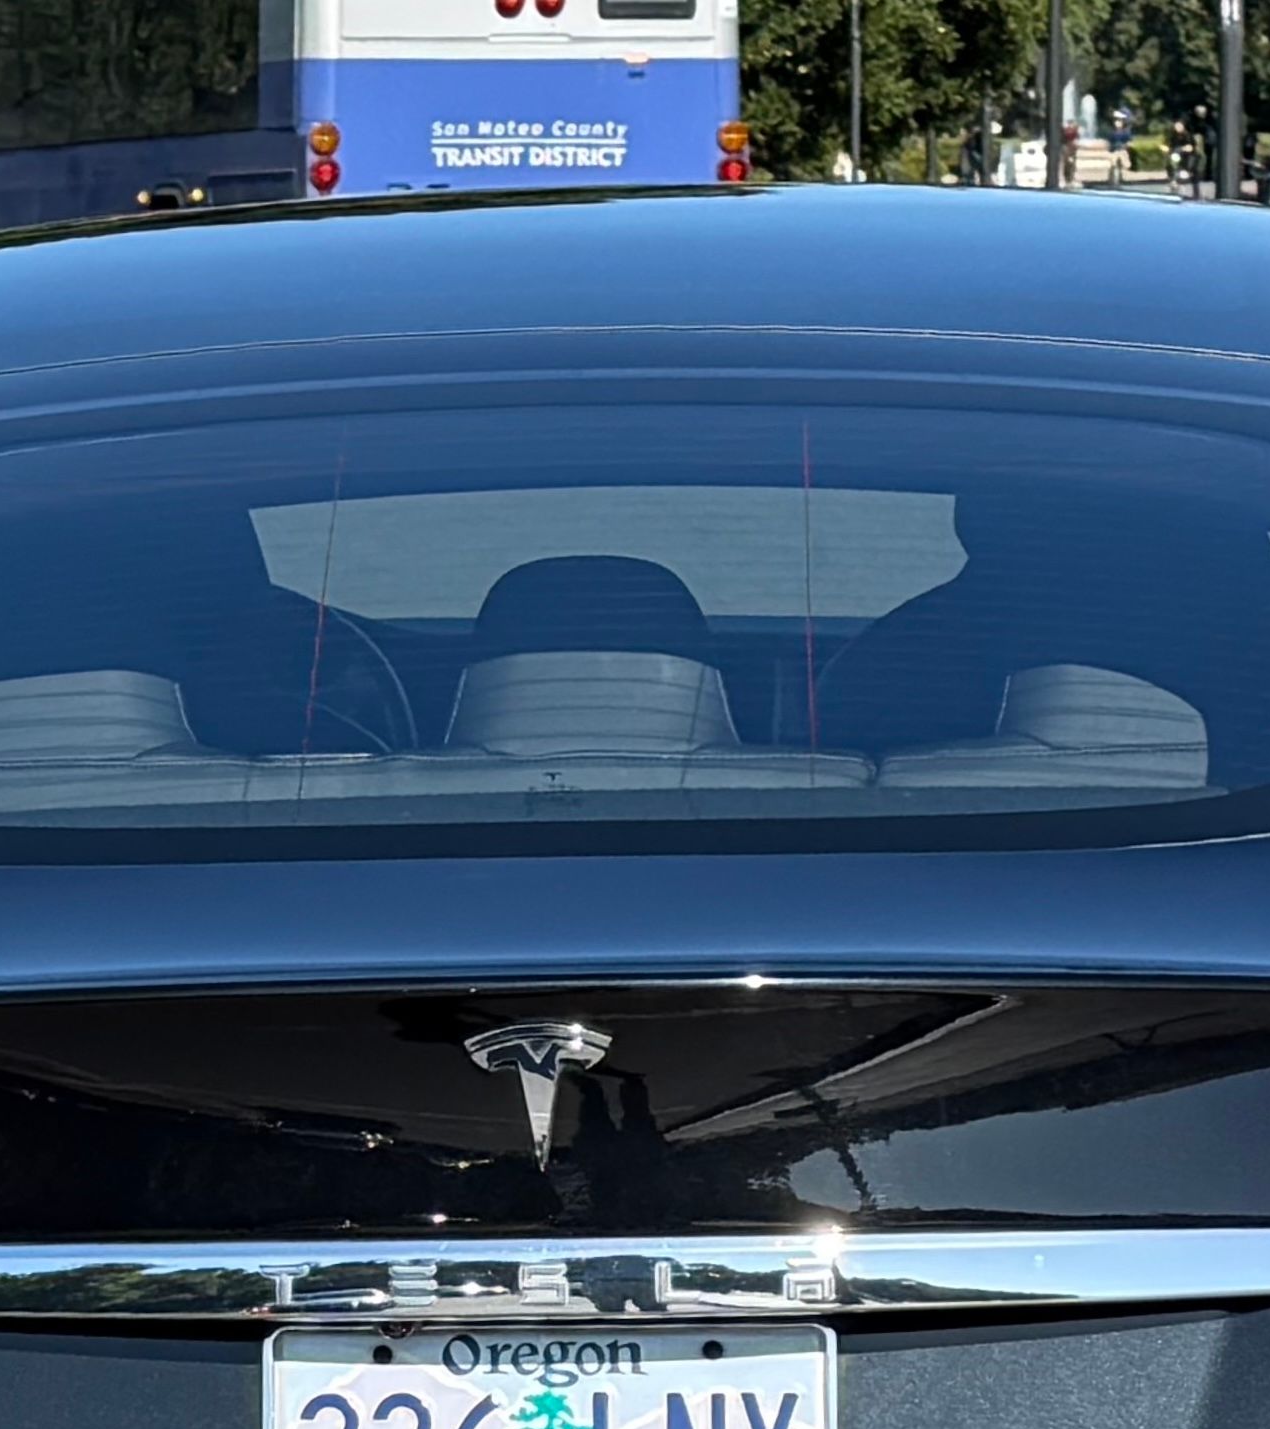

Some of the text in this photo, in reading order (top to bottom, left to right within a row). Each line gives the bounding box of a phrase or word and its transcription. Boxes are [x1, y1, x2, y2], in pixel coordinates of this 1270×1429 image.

[432, 147, 627, 167] TRANSIT DISTRICT
[259, 1257, 835, 1307] TESLA
[442, 1333, 647, 1388] Oregon
